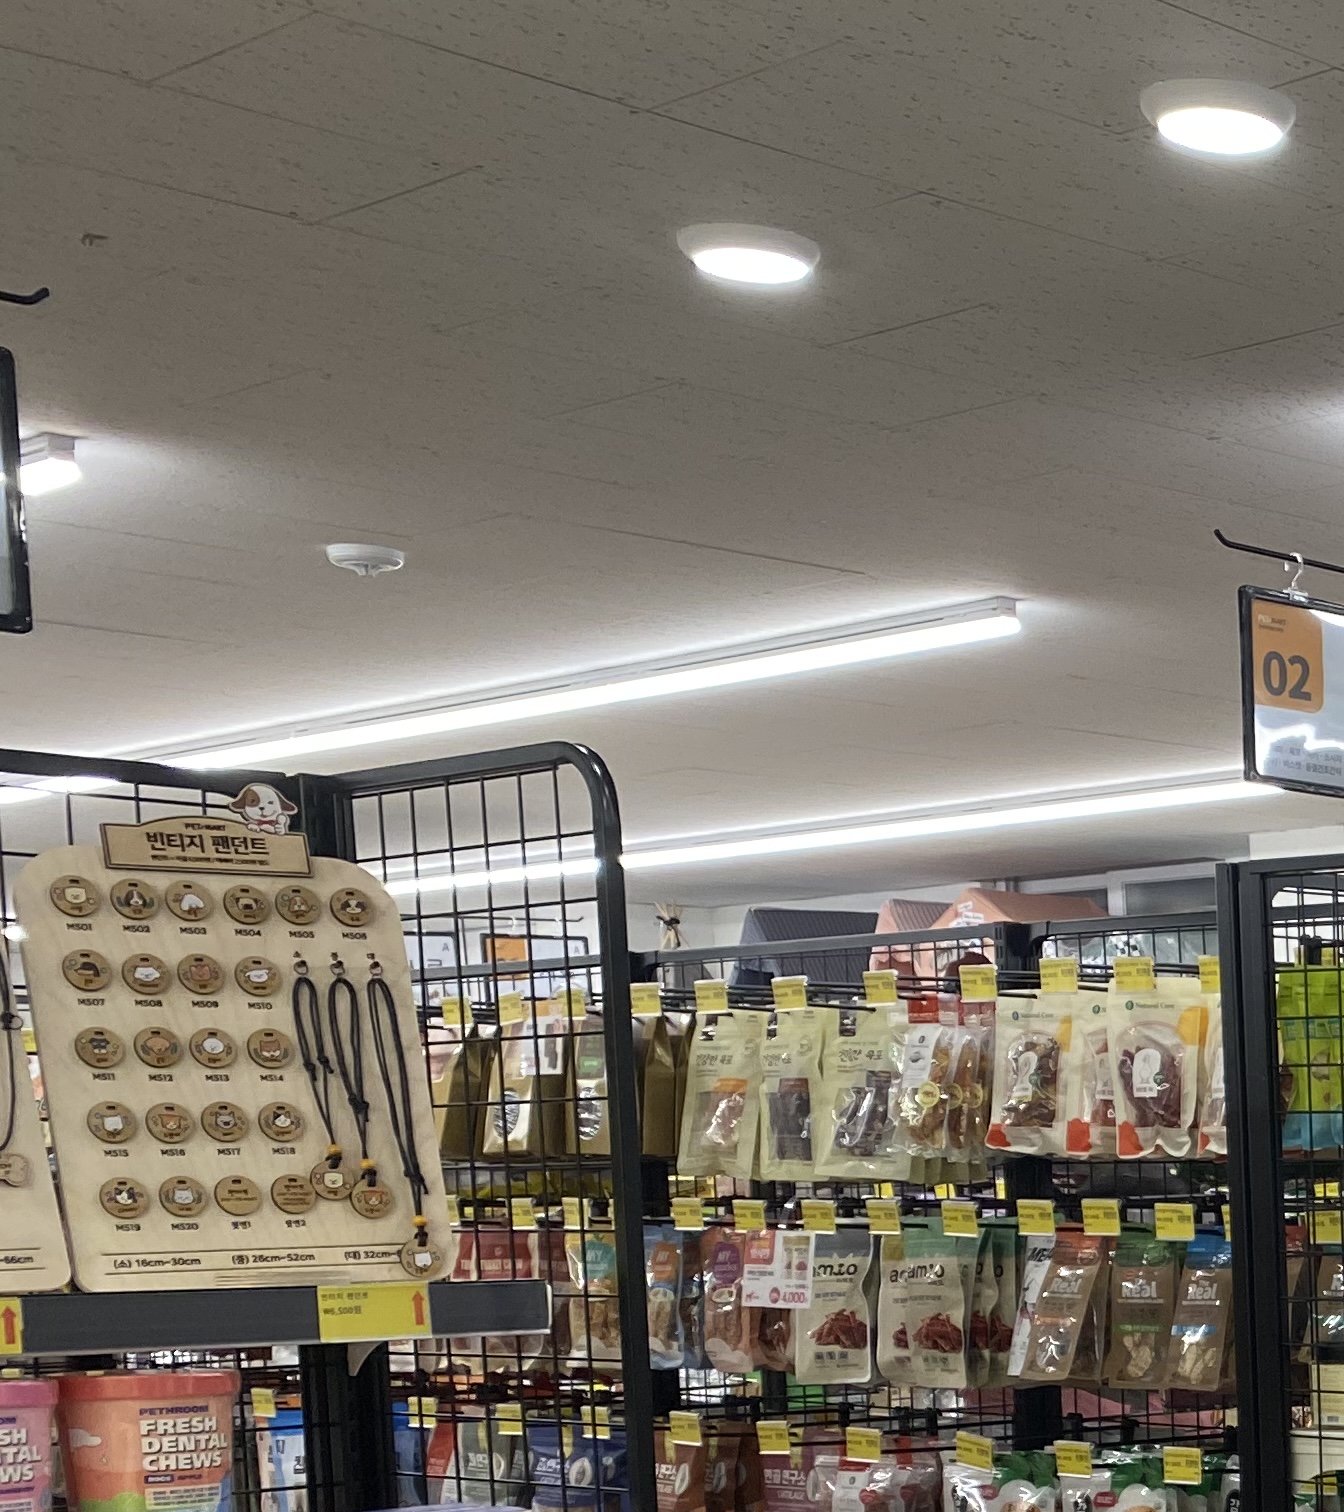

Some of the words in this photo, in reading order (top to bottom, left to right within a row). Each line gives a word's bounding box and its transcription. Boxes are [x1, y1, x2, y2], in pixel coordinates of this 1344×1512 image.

[1261, 650, 1313, 702] 02
[145, 831, 206, 854] 빈티지
[210, 835, 270, 857] 팬던트
[442, 943, 450, 952] A
[573, 946, 580, 954] A
[1120, 1280, 1157, 1298] Real
[139, 1404, 209, 1417] PETHROOM
[139, 1416, 218, 1436] FRESH
[141, 1433, 228, 1455] DENTAL
[142, 1450, 223, 1473] CHEWS
